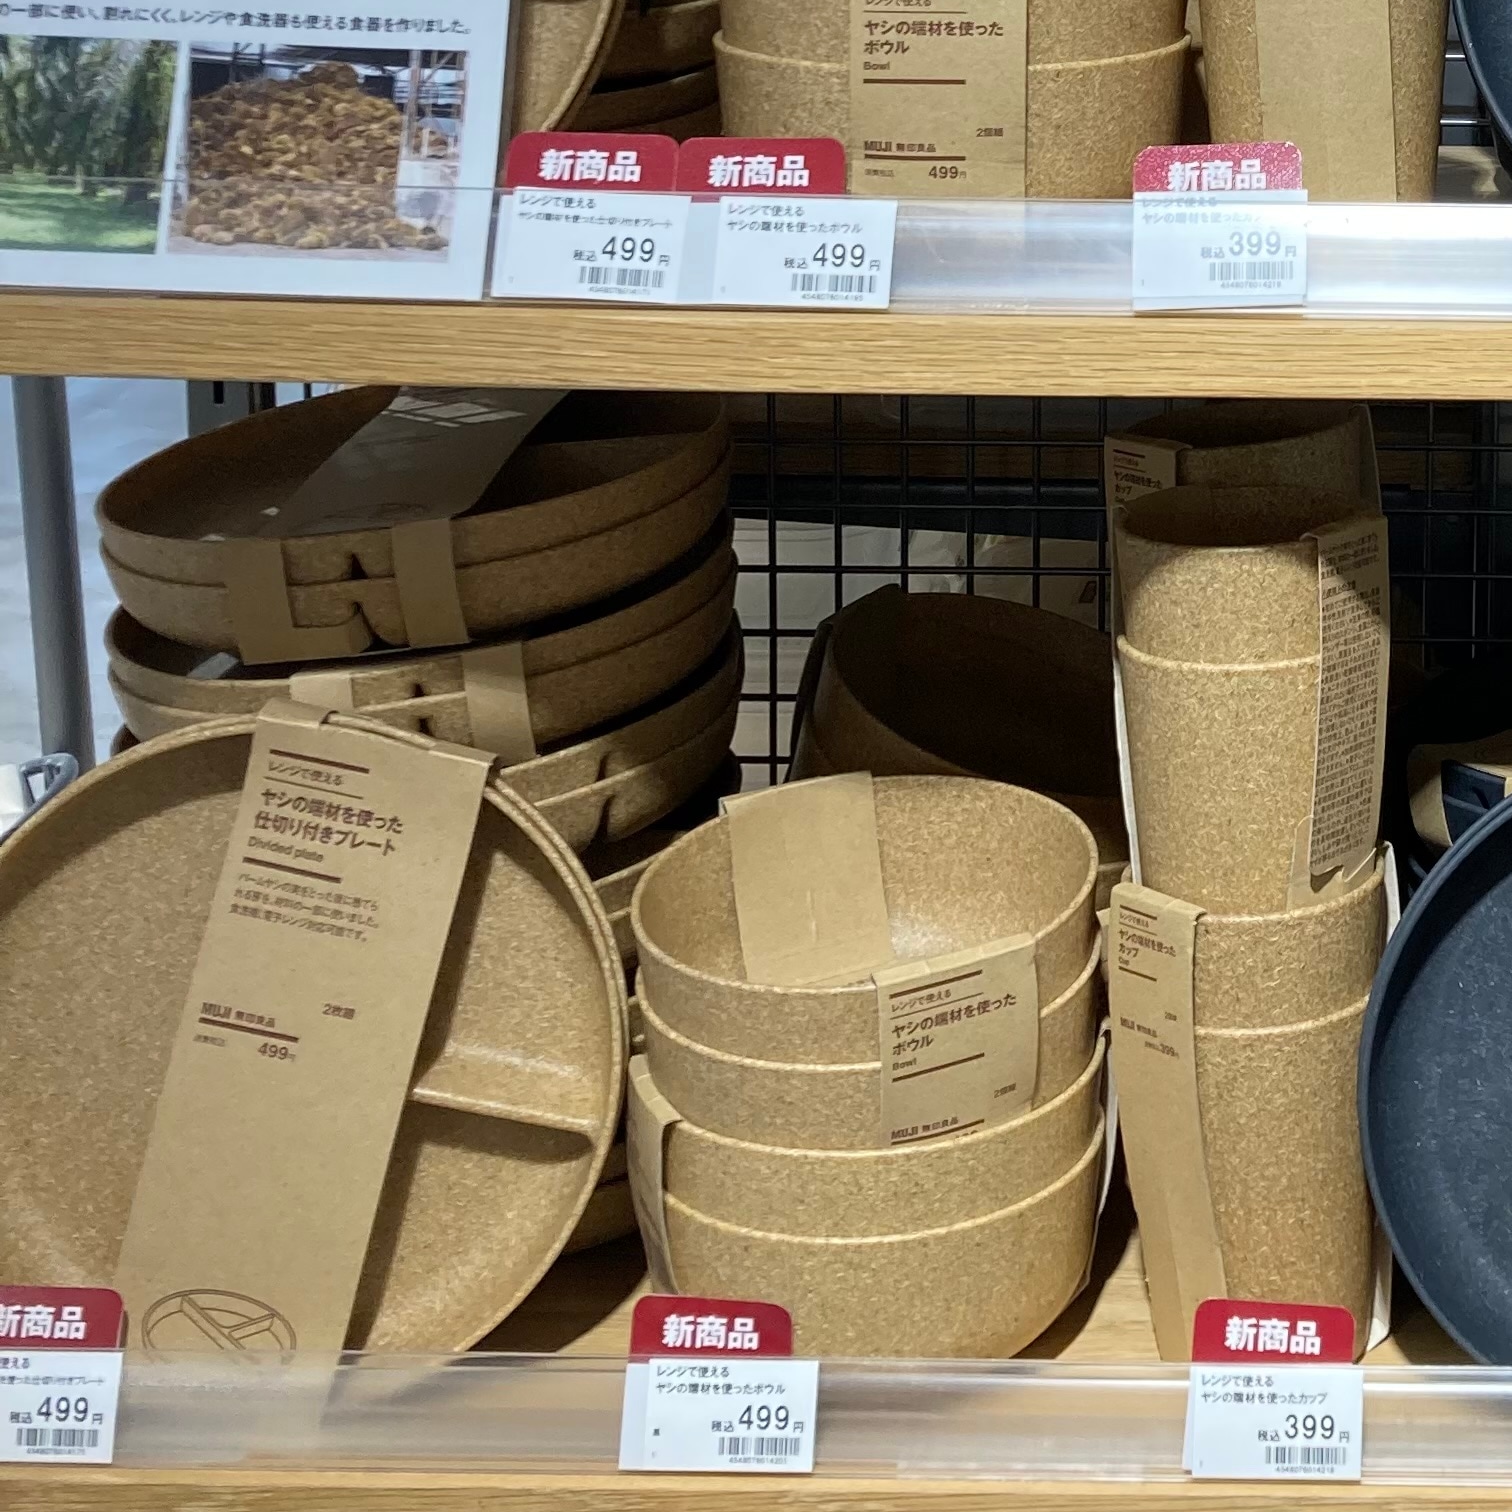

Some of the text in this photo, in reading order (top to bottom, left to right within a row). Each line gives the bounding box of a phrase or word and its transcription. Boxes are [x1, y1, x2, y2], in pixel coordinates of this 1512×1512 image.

[864, 20, 1003, 37] ヤシの端材を使った
[864, 40, 910, 55] ボウル
[864, 61, 890, 71] Bowl
[864, 140, 892, 152] MUJI
[538, 149, 642, 183] 新商品
[708, 155, 810, 187] 新商品
[1168, 158, 1267, 192] 新商品
[519, 194, 597, 209] レンジで使える
[728, 203, 805, 217] レンジで使える
[728, 221, 862, 234] ヤシの端材を使ったボウル
[1201, 246, 1225, 259] 税込
[261, 788, 404, 835] ヤシの端材を使った
[253, 811, 396, 856] 仕切り付きプレート
[892, 994, 1016, 1039] ヤシの端材を使った
[893, 1035, 934, 1056] ボウル
[662, 1314, 759, 1350] 新商品
[1224, 1316, 1321, 1355] 新商品
[657, 1366, 729, 1378] レンジで使える
[1201, 1375, 1274, 1387] レンジで使える
[656, 1383, 785, 1395] ヤシの端材を使ったボウル
[1201, 1392, 1327, 1404] ヤシの端材を使ったカップ
[712, 1421, 734, 1432] 税込
[1258, 1430, 1280, 1441] 税込
